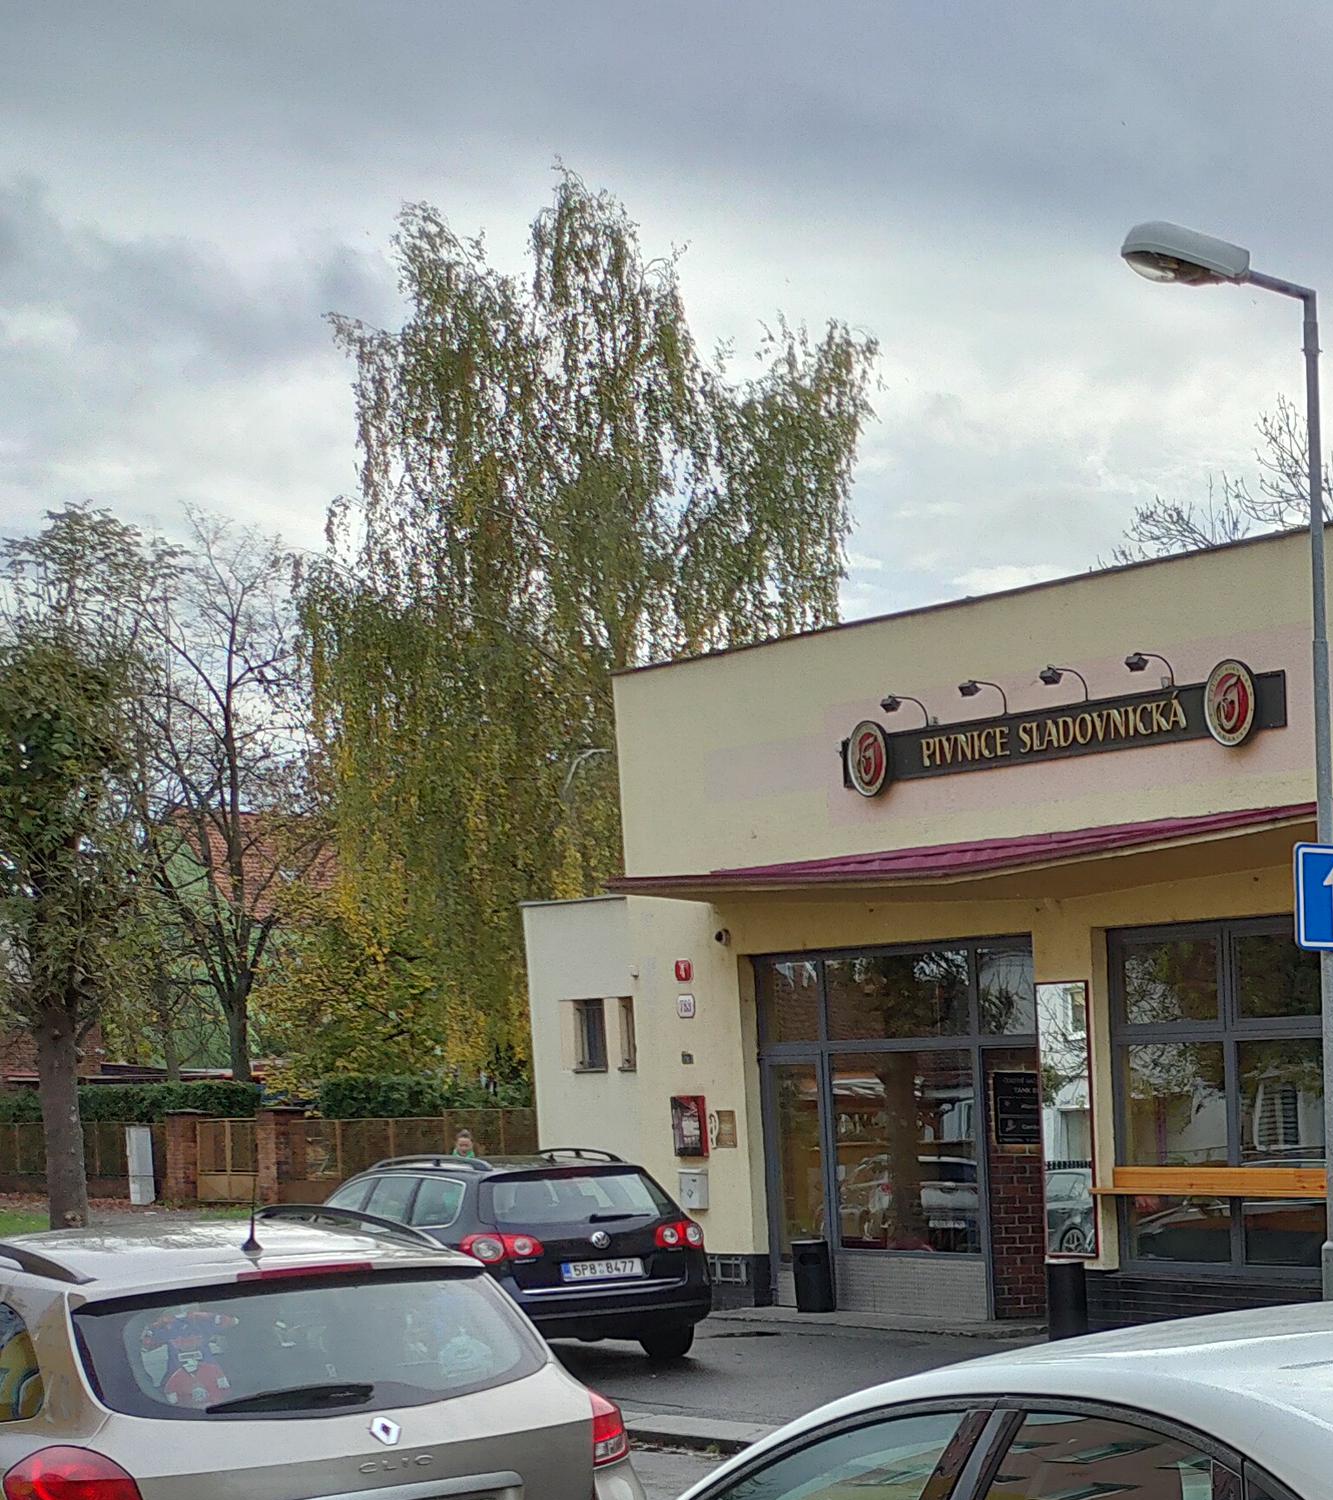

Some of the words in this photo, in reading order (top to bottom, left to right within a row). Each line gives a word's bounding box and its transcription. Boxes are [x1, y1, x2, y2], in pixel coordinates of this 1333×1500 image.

[920, 726, 1010, 767] PIVNICE
[1018, 691, 1188, 753] SLADOVNICKÁ
[573, 1263, 597, 1277] 5P8
[606, 1260, 635, 1274] 8477
[358, 1454, 434, 1473] CLIO
